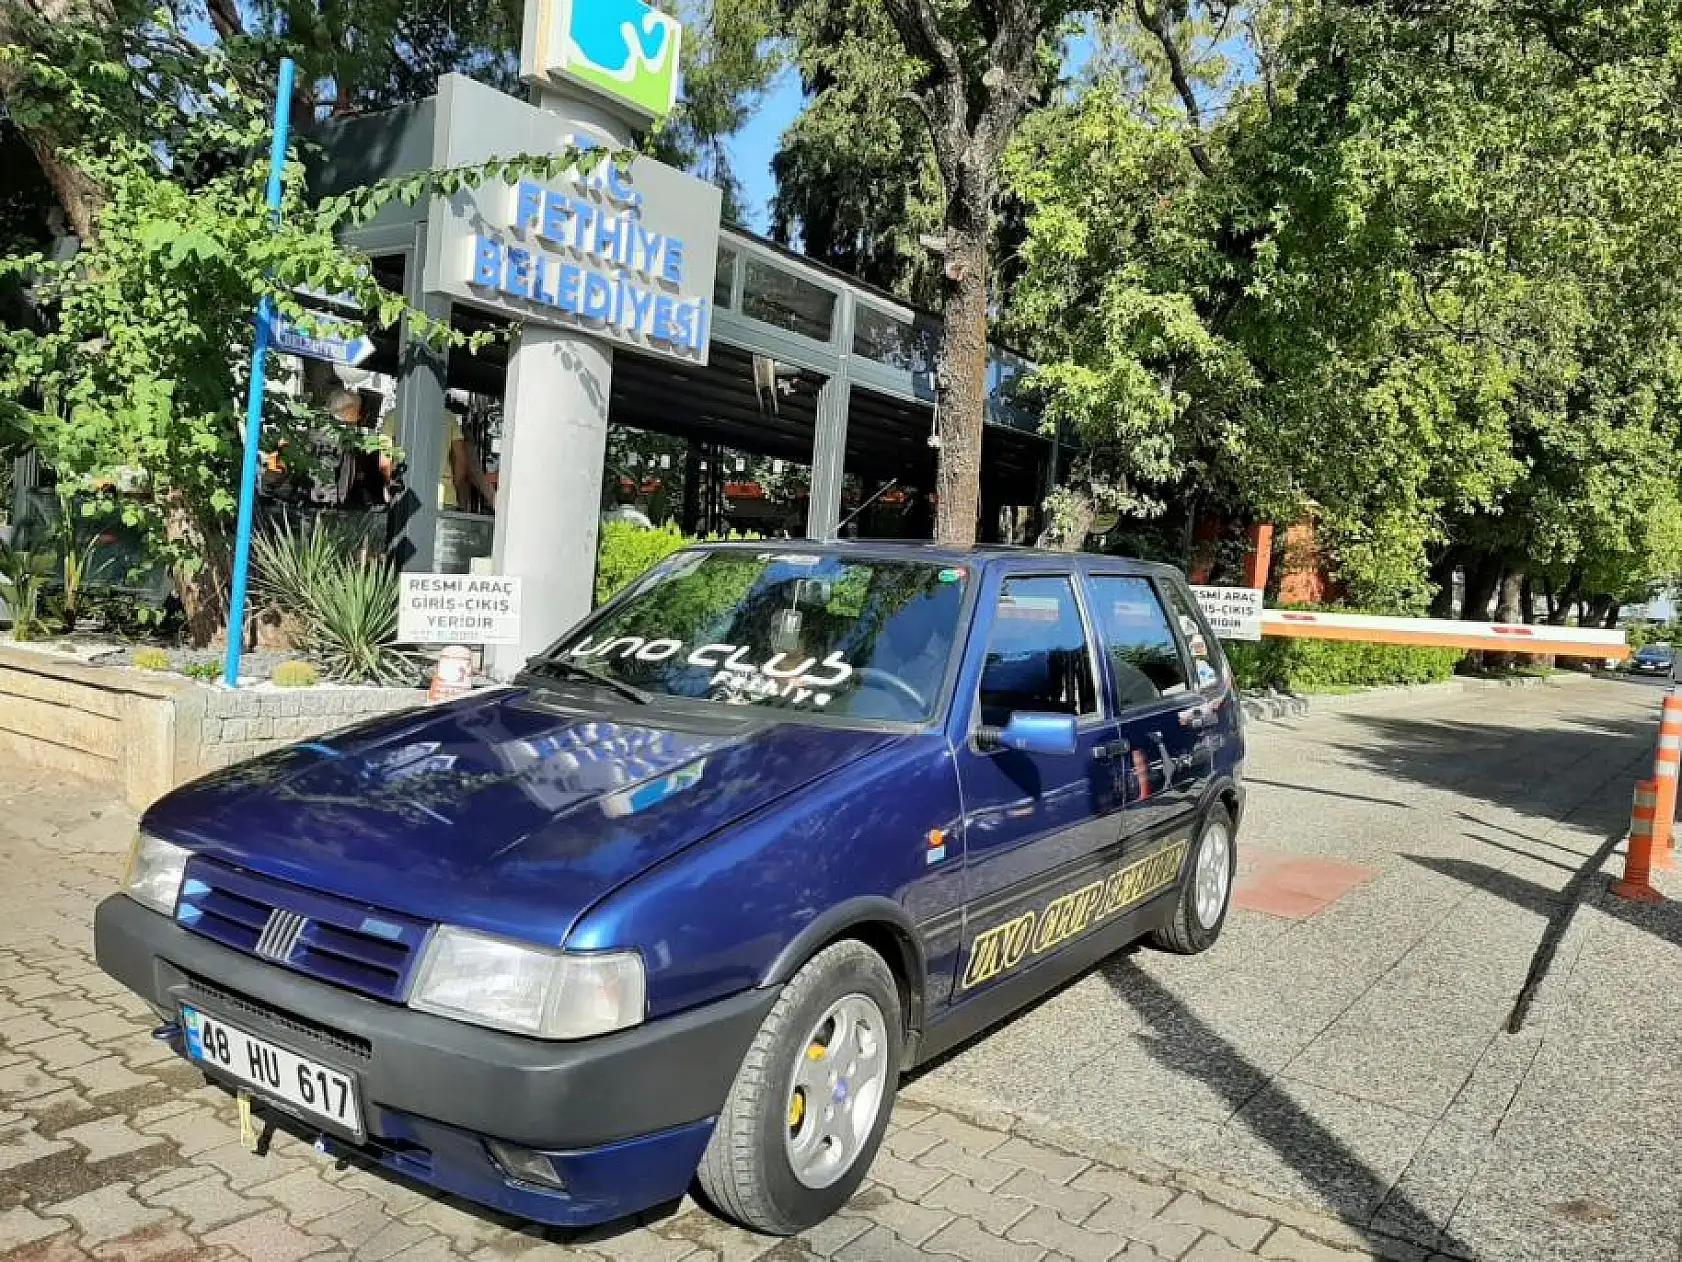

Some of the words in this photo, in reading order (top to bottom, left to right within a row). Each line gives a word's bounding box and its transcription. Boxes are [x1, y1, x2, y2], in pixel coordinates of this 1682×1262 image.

[513, 180, 685, 286] FETHİYE
[472, 235, 707, 350] BELEDİYESİ
[409, 578, 462, 592] RESMİ
[468, 580, 512, 596] ARAÇ
[1194, 588, 1221, 600] SMİ
[427, 613, 494, 629] YERİDİR
[1210, 616, 1241, 628] RİDİR
[203, 1020, 231, 1065] 48
[247, 1040, 280, 1088] HU
[297, 1063, 348, 1118] 617
